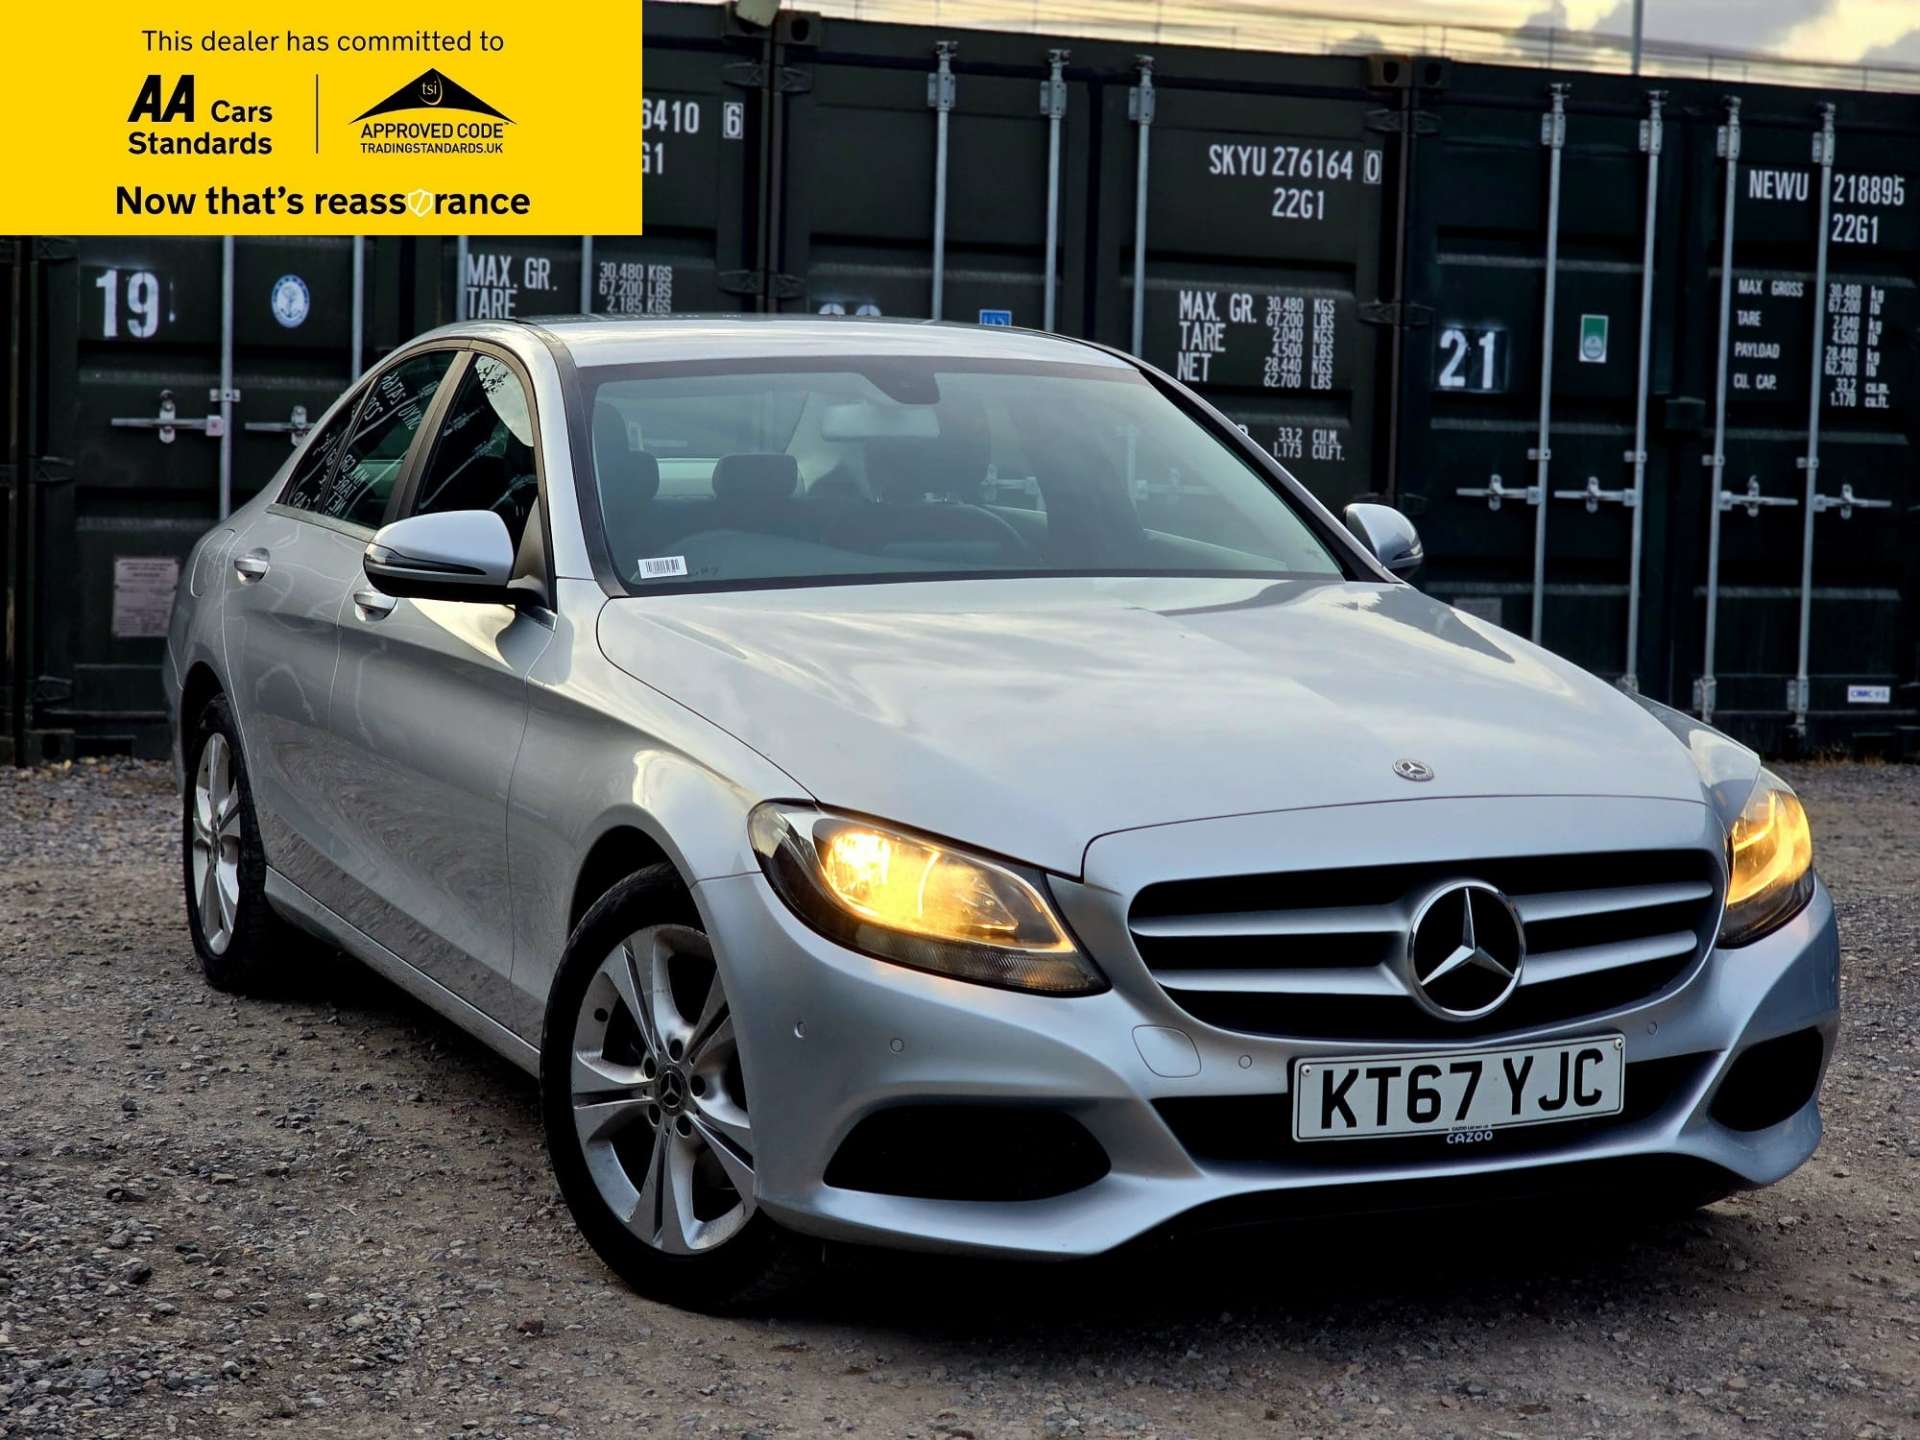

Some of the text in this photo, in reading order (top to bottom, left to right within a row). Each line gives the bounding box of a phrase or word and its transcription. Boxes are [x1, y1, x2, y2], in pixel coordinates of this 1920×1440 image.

[725, 104, 742, 137] 6
[1209, 144, 1266, 176] SKYU
[1272, 146, 1353, 180] 276164
[1749, 169, 1905, 206] NEWU 218895
[1272, 187, 1325, 220] 22G1
[1832, 213, 1879, 244] 22G1
[466, 253, 558, 291] MAX. GR.
[648, 264, 672, 282] KGS
[1738, 279, 1762, 295] MAX
[96, 269, 159, 338] 19
[467, 287, 517, 320] TARE
[647, 281, 672, 298] LBS
[647, 297, 671, 314] KGS
[1179, 290, 1257, 324] MAX. GR.
[1314, 298, 1335, 314] KGS
[1179, 320, 1227, 352] TARE
[1312, 329, 1334, 344] KGS
[1313, 314, 1334, 329] LBS
[1312, 344, 1333, 359] LBS
[1440, 329, 1495, 389] 21
[1735, 341, 1780, 359] PAYLOAD
[1177, 352, 1211, 382] NET
[1311, 359, 1333, 374] KGS
[1310, 374, 1332, 390] LBS
[1321, 1048, 1604, 1130] KT67 YJC
[1446, 1130, 1493, 1144] CAZOO
